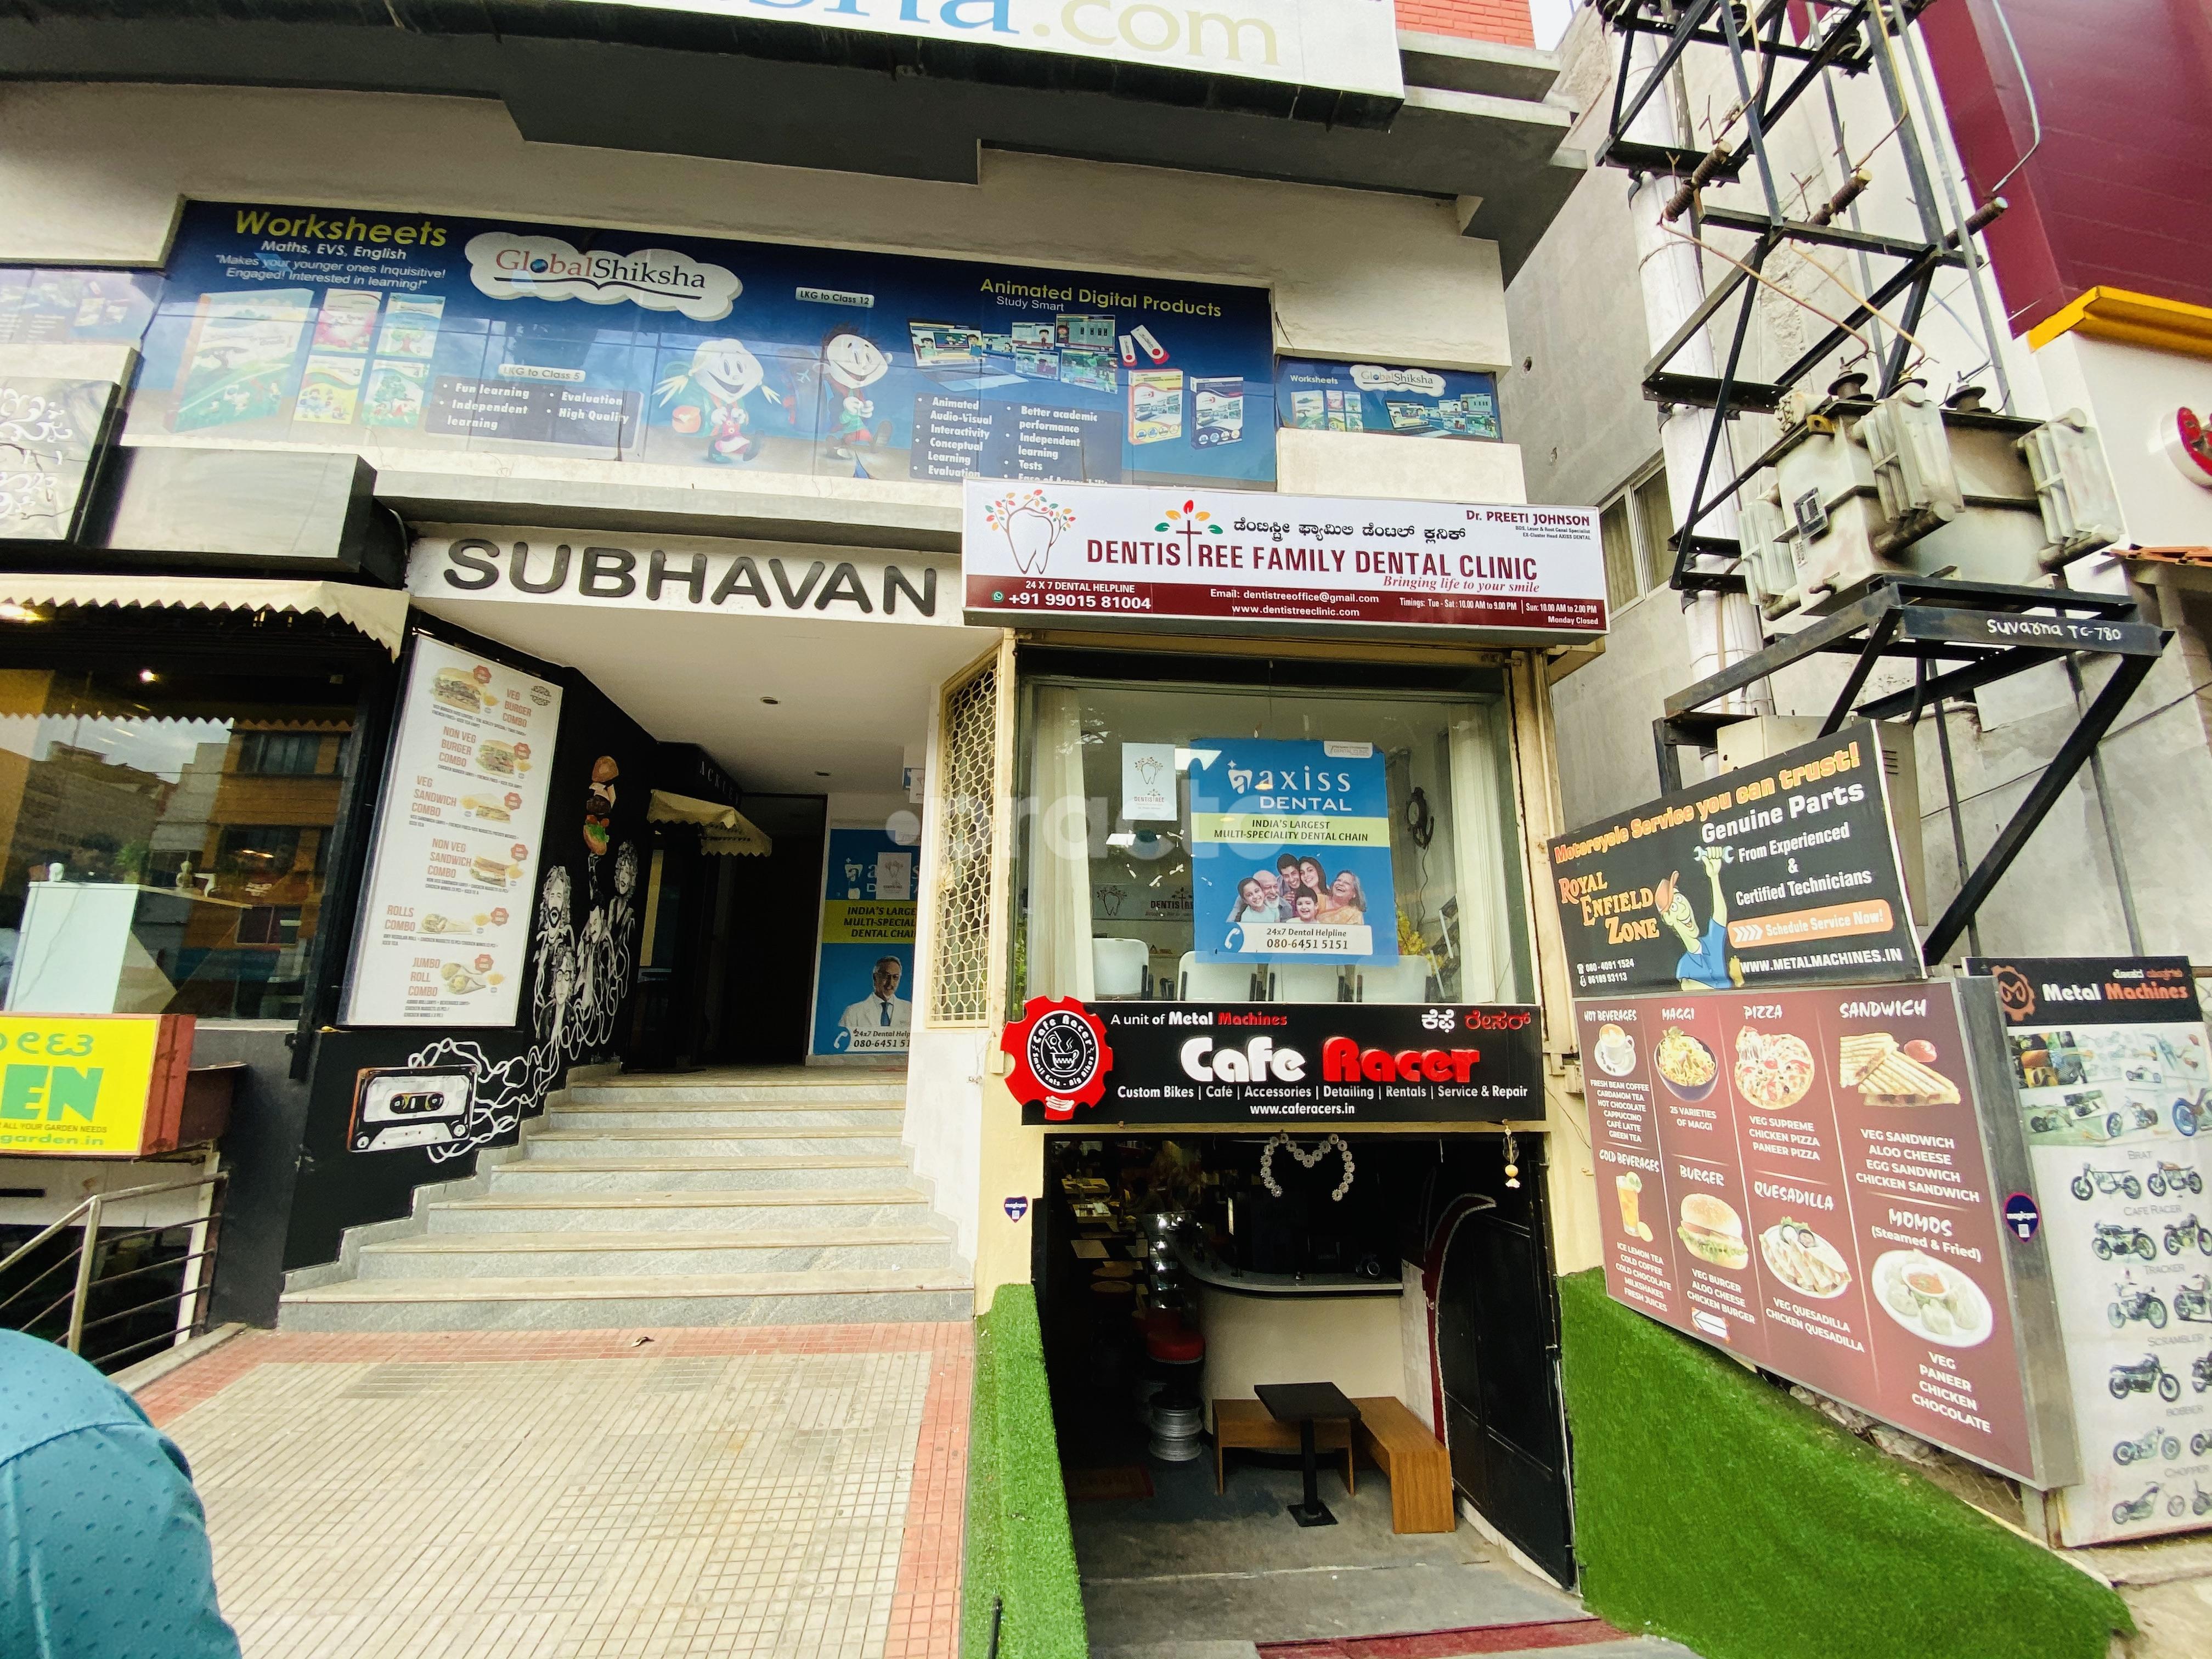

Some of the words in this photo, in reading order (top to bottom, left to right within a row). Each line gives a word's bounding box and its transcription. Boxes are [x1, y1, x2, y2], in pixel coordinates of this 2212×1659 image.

[236, 210, 447, 247] Worksheets
[261, 240, 311, 254] Maths,
[317, 242, 348, 257] EVS,
[354, 246, 407, 261] English
[226, 268, 286, 282] Engaged!
[289, 270, 351, 285] Interested
[354, 275, 365, 285] in
[262, 258, 289, 270] your
[294, 261, 342, 273] younger
[346, 263, 376, 273] ones
[380, 261, 445, 279] Inquisitive!
[495, 249, 706, 290] GlobalShiksha
[800, 290, 818, 299] LKG
[832, 294, 856, 303] Class
[980, 278, 1072, 301] Animated
[1079, 289, 1137, 308] Digital
[1143, 297, 1222, 317] Products
[996, 296, 1029, 309] Study
[1031, 299, 1064, 312] Smart
[1290, 375, 1339, 385] Worksheets
[1361, 370, 1434, 385] GlobalShiksha
[932, 397, 979, 410] Animated
[930, 410, 992, 425] Audio-Visual
[1021, 405, 1051, 418] Better
[1053, 408, 1098, 422] academic
[930, 424, 990, 439] Interactivity
[1019, 420, 1080, 433] performance
[929, 437, 983, 453] Conceptual
[1019, 432, 1081, 447] Independent
[928, 451, 971, 466] Learning
[1018, 445, 1059, 460] learning
[1019, 459, 1043, 471] Tests
[1466, 510, 1482, 521] Dr.
[1486, 511, 1529, 523] PREETI
[1533, 513, 1590, 526] JOHNSON
[1087, 520, 1243, 569] DENTISTREE
[1253, 546, 1346, 573] FAMILY
[1355, 550, 1451, 576] DENTAL
[1459, 554, 1538, 580] CLINIC
[444, 538, 936, 617] SUBHAVAN
[1383, 575, 1437, 591] Bringing
[1440, 578, 1460, 590] life
[1463, 580, 1475, 590] to
[1477, 582, 1505, 594] your
[1508, 580, 1541, 593] smile
[1025, 580, 1037, 590] 24
[1037, 581, 1046, 590] X
[1046, 582, 1053, 591] 7
[1054, 582, 1091, 592] DENTAL
[1093, 583, 1136, 594] HELPLINE
[1210, 588, 1240, 599] Email:
[1243, 589, 1380, 603] dentistreeoffice@gmail.com
[1008, 593, 1039, 606] +91
[1045, 594, 1096, 608] 99015
[1100, 596, 1152, 610] 81004
[1231, 605, 1360, 617] www.dentistreeclinic.com
[1548, 616, 1575, 625] Monday
[1576, 617, 1599, 625] Closed
[2069, 624, 2122, 642] TC-780
[443, 726, 460, 741] NON
[461, 729, 477, 744] VEG
[441, 739, 472, 756] BURGER
[438, 752, 467, 768] COMBO
[416, 775, 433, 788] VEG
[1259, 765, 1351, 793] axiss
[413, 788, 457, 807] SANDWICH
[1260, 796, 1352, 811] DENTAL
[1554, 824, 1629, 865] Motorcycle
[1630, 804, 1695, 839] Service
[1696, 790, 1733, 822] you
[1735, 776, 1777, 805] can
[1779, 741, 1861, 791] trust!
[411, 802, 441, 817] COMBO
[1701, 805, 1784, 844] Genuine
[1788, 782, 1865, 820] Parts
[1251, 819, 1288, 829] INDIA'S
[1290, 820, 1330, 830] LARGEST
[1214, 830, 1299, 840] MULTI-SPECIALITY
[1300, 831, 1337, 841] DENTAL
[1338, 832, 1368, 842] CHAIN
[1737, 844, 1768, 863] From
[1769, 821, 1850, 860] Experienced
[1787, 859, 1799, 874] &
[1558, 870, 1608, 905] ROYAL
[1735, 884, 1786, 907] Certified
[1787, 868, 1872, 898] Technicians
[387, 905, 414, 917] ROLLS
[847, 906, 884, 916] INDIA'S
[1581, 887, 1655, 927] ENFIELD
[384, 919, 416, 932] COMBO
[1605, 916, 1661, 945] ZONE
[1765, 915, 1809, 938] Schedule
[1810, 910, 1852, 930] Service
[1853, 906, 1884, 926] Now!
[1266, 928, 1286, 936] 24x7
[1288, 928, 1313, 937] Dental
[1315, 928, 1347, 938] Helpline
[1267, 938, 1318, 950] 080-6451
[1321, 939, 1348, 950] 5151
[1739, 947, 1903, 974] WWW.METALMACHINES.IN
[2041, 983, 2102, 1002] Metal
[2103, 980, 2190, 1000] Machines
[1584, 1010, 1597, 1022] HOT
[1597, 1008, 1638, 1022] BEVERAGES
[1661, 1007, 1695, 1021] MAGGI
[1742, 1004, 1783, 1020] PIZZA
[1839, 998, 1927, 1019] SANDWICH
[1110, 1014, 1121, 1025] A
[1123, 1013, 1149, 1025] unit
[1152, 1013, 1166, 1025] of
[1167, 1011, 1214, 1025] Metal
[1217, 1011, 1288, 1026] Machines
[1179, 1035, 1307, 1084] Cafe
[1322, 1035, 1480, 1084] Racer
[1116, 1086, 1162, 1098] Custom
[1163, 1085, 1194, 1098] Bikes
[1205, 1085, 1233, 1098] Café
[1244, 1086, 1312, 1098] Accessories
[1322, 1085, 1374, 1100] Detailing
[1385, 1085, 1427, 1098] Rentals
[1437, 1085, 1479, 1098] Service
[1481, 1086, 1490, 1097] &
[1492, 1085, 1528, 1099] Repair
[1250, 1102, 1355, 1115] www.caferacers.in
[44, 1123, 78, 1132] GARDEN
[1748, 1115, 1768, 1127] VEG
[1769, 1117, 1815, 1132] SUPREME
[1748, 1128, 1789, 1143] CHICKEN
[1791, 1134, 1821, 1147] PIZZA
[1860, 1127, 1884, 1141] VEG
[1885, 1131, 1955, 1149] SANDWICH
[1752, 1141, 1789, 1156] PANEER
[1790, 1147, 1821, 1161] PIZZA
[1869, 1144, 1901, 1158] ALOO
[1903, 1149, 1953, 1166] CHEESE
[1599, 1149, 1617, 1164] COLD
[1617, 1153, 1660, 1173] BEVERAGES
[1679, 1164, 1725, 1187] BURGER
[1865, 1158, 1889, 1172] EGG
[1891, 1162, 1961, 1183] SANDWICH
[1754, 1181, 1835, 1211] QUESADILLA
[1855, 1172, 1906, 1190] CHICKEN
[1908, 1180, 1980, 1203] SANDWICH
[1888, 1207, 1954, 1237] MOMOS
[1918, 1363, 1972, 1392] PANEER
[1911, 1392, 1993, 1435] CHOCOLATE
